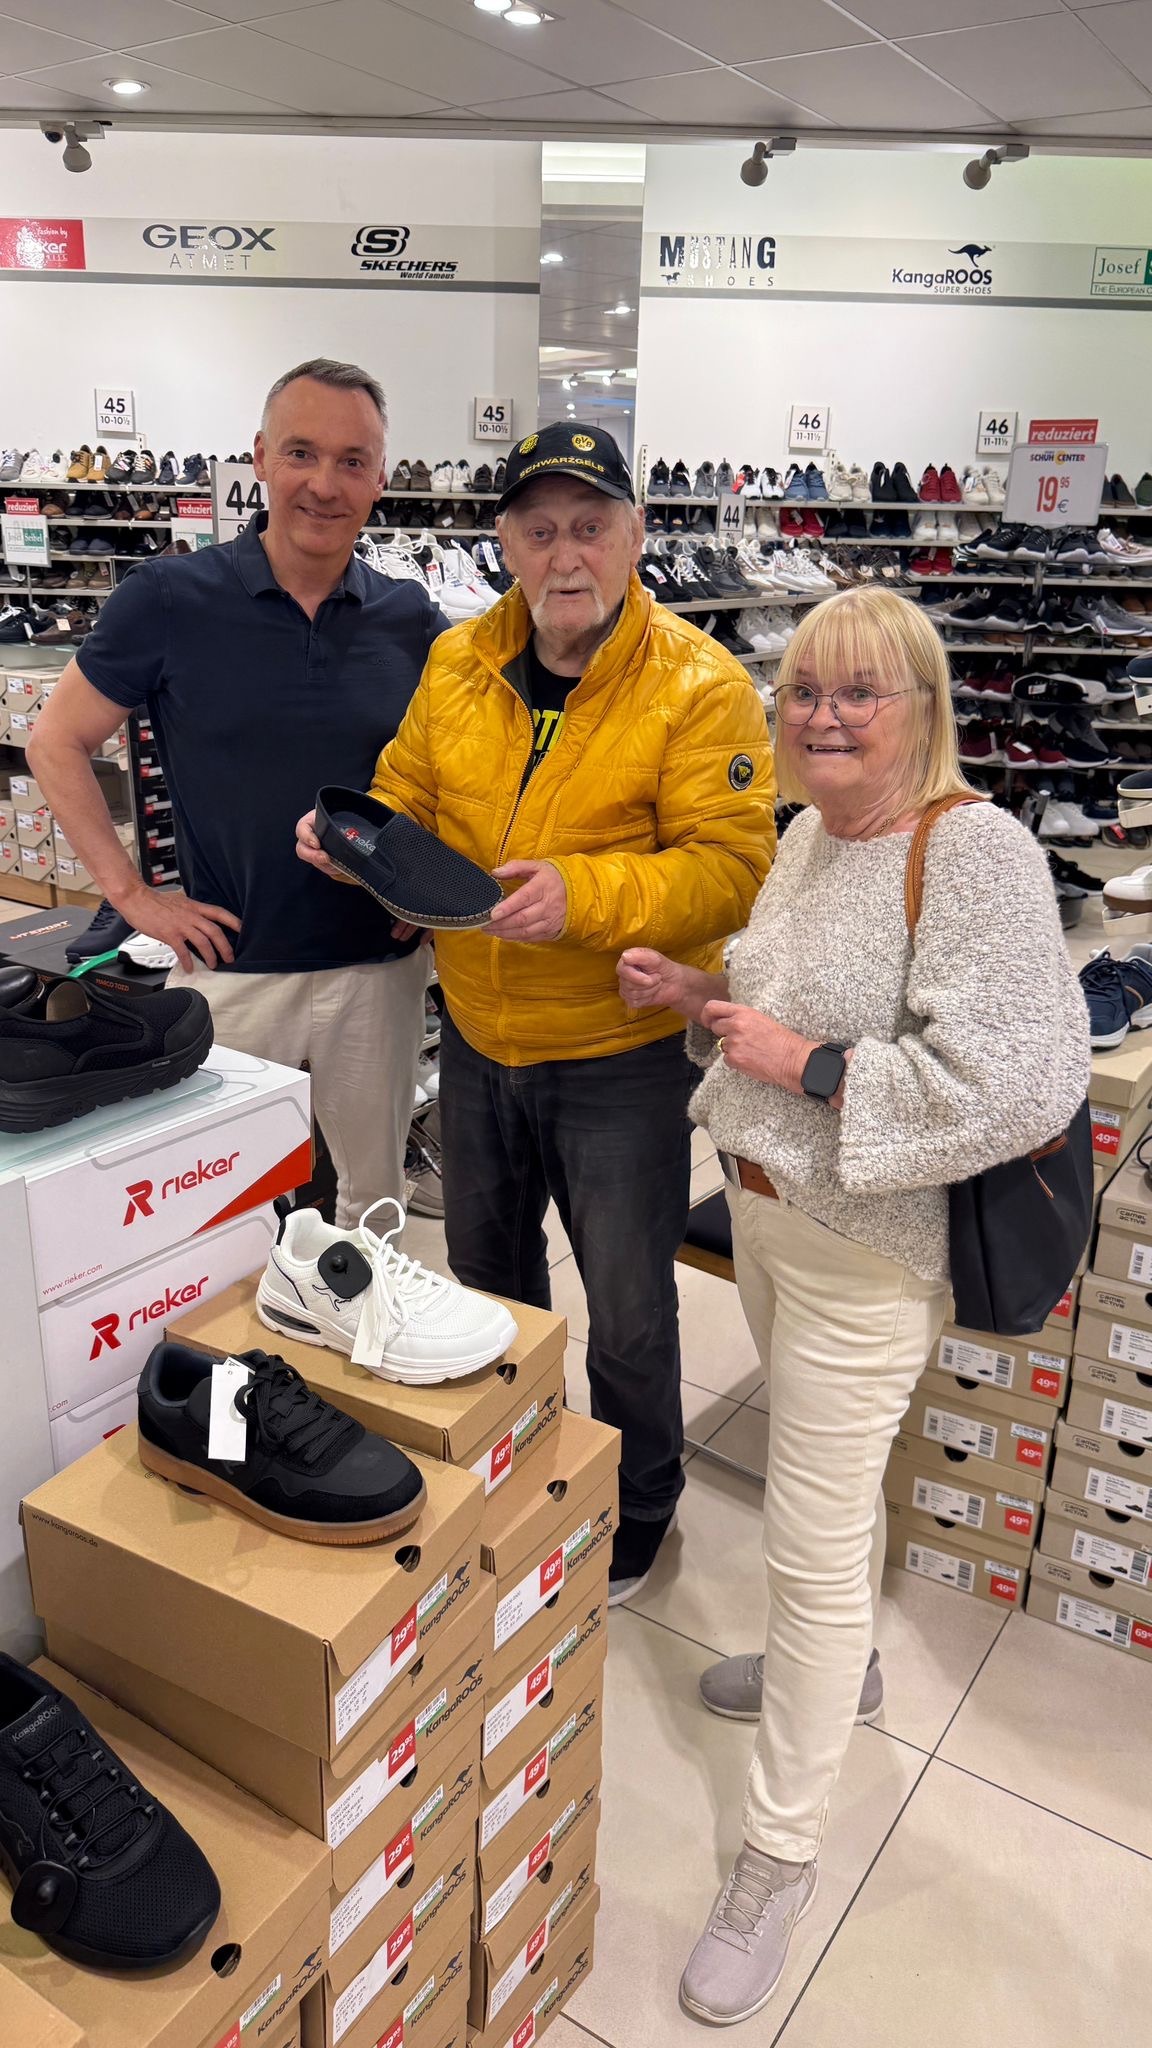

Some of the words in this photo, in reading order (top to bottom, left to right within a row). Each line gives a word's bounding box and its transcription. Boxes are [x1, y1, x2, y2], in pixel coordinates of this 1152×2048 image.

[142, 224, 276, 251] GEOX
[660, 236, 776, 269] MUSTANG
[360, 260, 458, 271] SKECHERS
[687, 275, 774, 286] SHOES
[892, 268, 992, 288] KangaROOS
[1098, 258, 1141, 276] Josef
[934, 286, 960, 294] SUPER
[963, 286, 992, 294] SHOES
[104, 397, 126, 414] 45
[483, 405, 505, 422] 45
[799, 413, 821, 429] 46
[986, 418, 1009, 434] 46
[1031, 427, 1094, 441] reduziert
[519, 457, 605, 479] SCHWARZGELB
[1030, 453, 1055, 462] SCHUH
[1056, 453, 1086, 462] CENTER
[7, 501, 39, 512] reduziert
[226, 480, 265, 516] 44
[1037, 476, 1059, 513] 19
[179, 505, 212, 515] reduziert
[723, 505, 740, 528] 44
[162, 1151, 240, 1200] rieker
[42, 1262, 103, 1296] www.rieker.com
[129, 1275, 209, 1331] rieker
[515, 1407, 558, 1456] KangaROOS
[566, 1520, 613, 1571] KangaROOS
[419, 1576, 471, 1640] KangaROOS
[556, 1616, 602, 1669] KangaROOS
[426, 1673, 483, 1738] KangaROOS
[12, 1705, 61, 1742] KangaROOS
[420, 1776, 473, 1840] KangaROOS
[415, 1869, 467, 1936] KangaROOS
[258, 1957, 323, 2038] KangaROOS
[411, 1961, 463, 2028] KangaROOS
